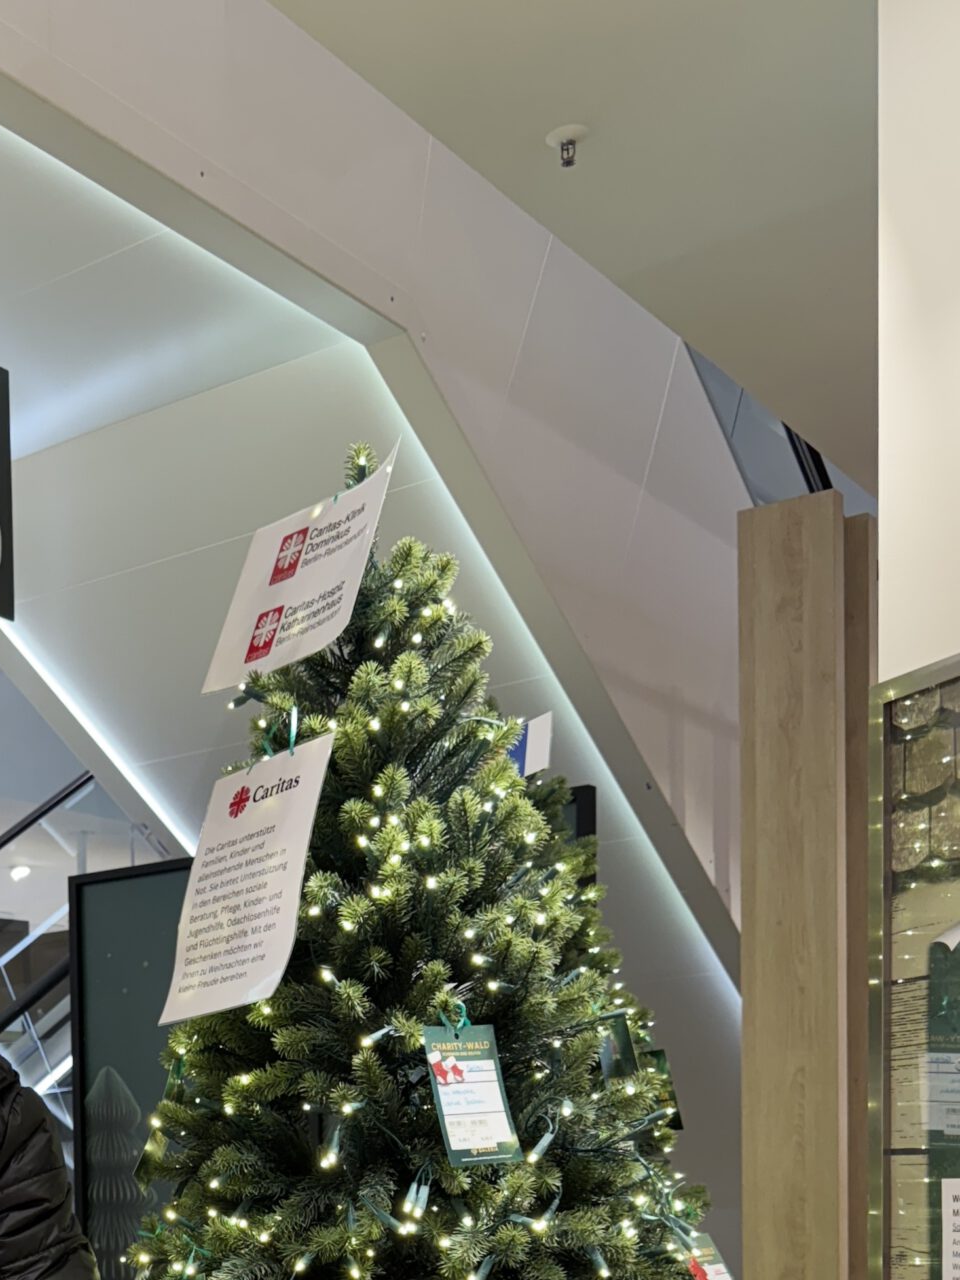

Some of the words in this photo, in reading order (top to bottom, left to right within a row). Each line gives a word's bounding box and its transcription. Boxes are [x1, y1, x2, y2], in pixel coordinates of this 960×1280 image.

[309, 502, 366, 540] Caritas-Klinik
[305, 526, 351, 555] Dominikus
[252, 774, 301, 804] Caritas
[216, 838, 238, 852] Caritas
[229, 847, 250, 860] Kinder
[251, 841, 266, 852] und
[244, 851, 279, 868] Menschen
[208, 883, 219, 893] Sie
[219, 876, 239, 889] bietet
[240, 861, 289, 882] Unterstützung
[199, 898, 211, 908] den
[212, 888, 245, 905] Bereichen
[245, 881, 268, 895] soziale
[269, 890, 283, 901] und
[185, 941, 199, 953] und
[250, 925, 262, 936] Mit
[263, 922, 277, 933] den
[184, 951, 222, 967] Geschenken
[223, 943, 252, 957] möchten
[250, 953, 267, 964] eine
[431, 1041, 491, 1052] CHARITY-WALD
